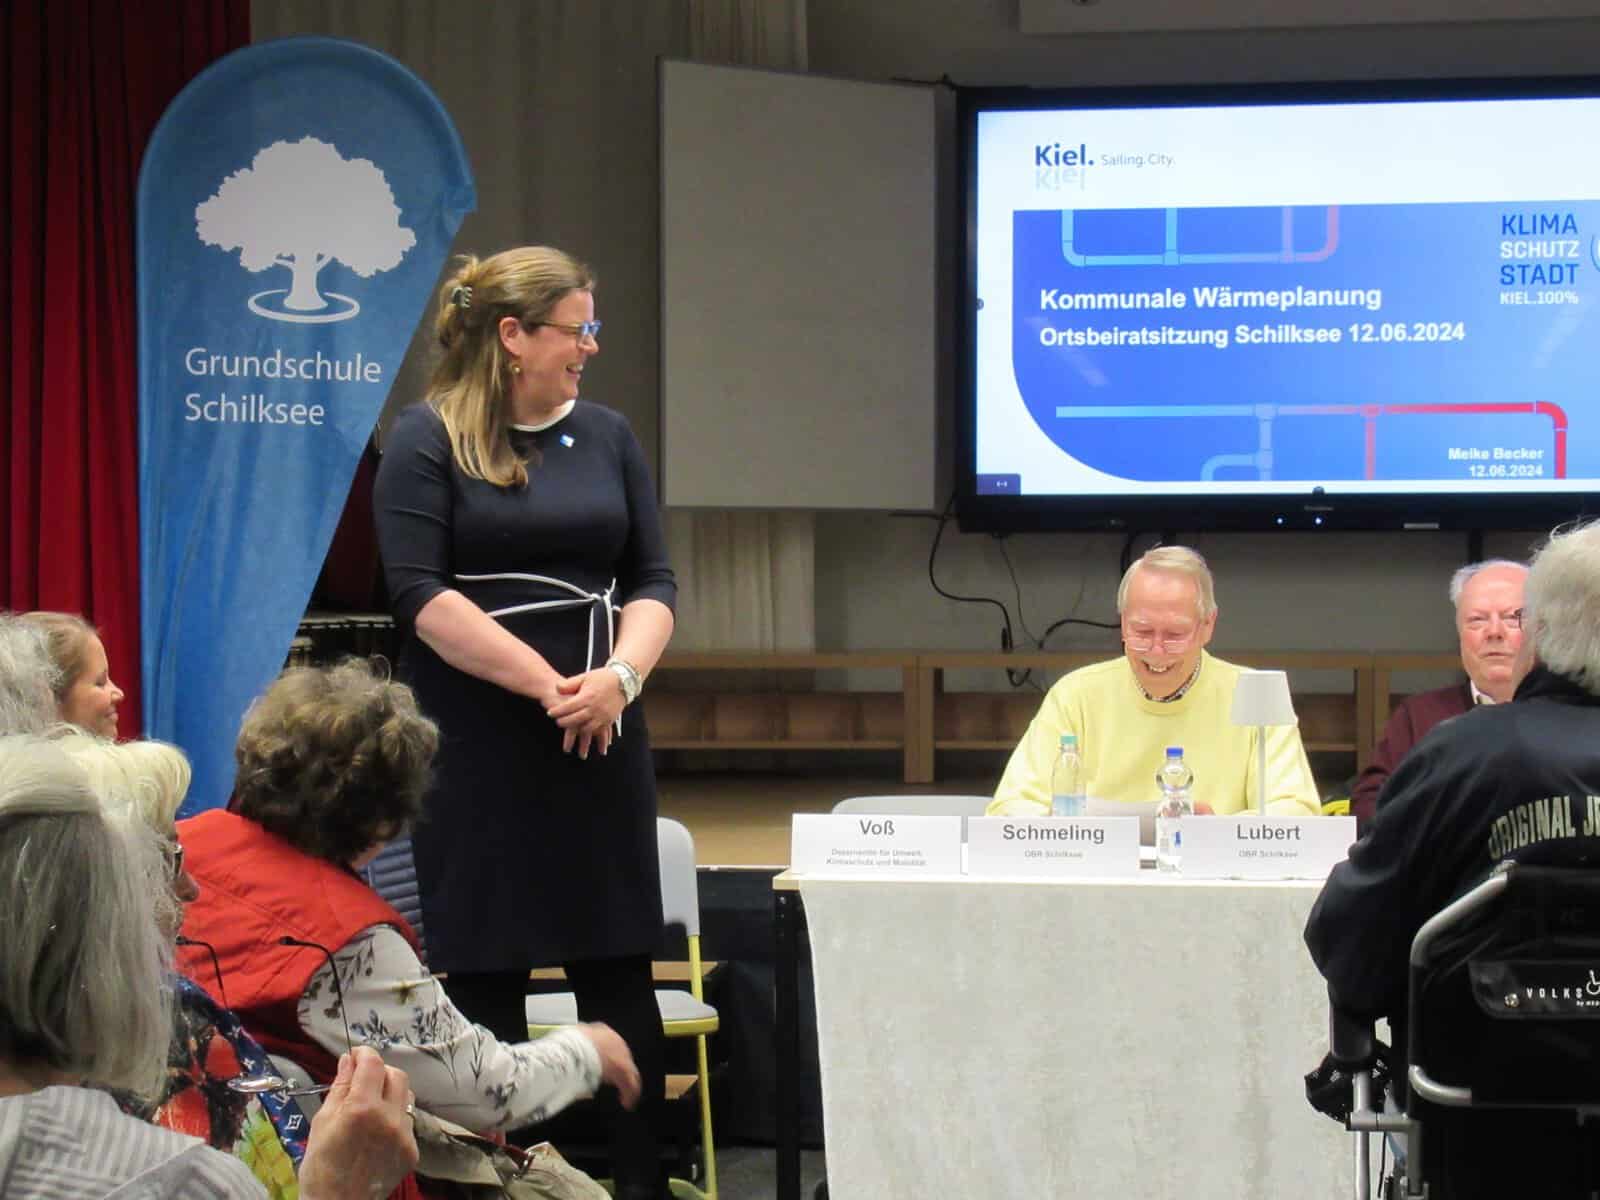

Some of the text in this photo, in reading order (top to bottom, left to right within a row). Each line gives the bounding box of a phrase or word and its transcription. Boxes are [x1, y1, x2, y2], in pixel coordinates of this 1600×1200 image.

[1035, 143, 1095, 167] Kiel.
[1501, 213, 1578, 235] KLIMA
[1501, 240, 1579, 258] SCHUTZ
[1500, 263, 1579, 285] STADT
[1040, 285, 1382, 311] Kommunale Wärmeplanung
[1039, 322, 1466, 348] Ortsbeiratsitzung Schilksee 12.06.2024
[185, 347, 382, 383] Grundschule
[185, 392, 325, 425] Schilksee
[1493, 447, 1544, 460] Becker
[1469, 464, 1544, 478] 12.06.2024
[859, 818, 896, 836] Voß
[1002, 824, 1105, 845] Schmeling
[1236, 823, 1301, 841] Lubert
[1488, 795, 1576, 860] ORIGINAL
[1526, 987, 1583, 999] VOLKS
